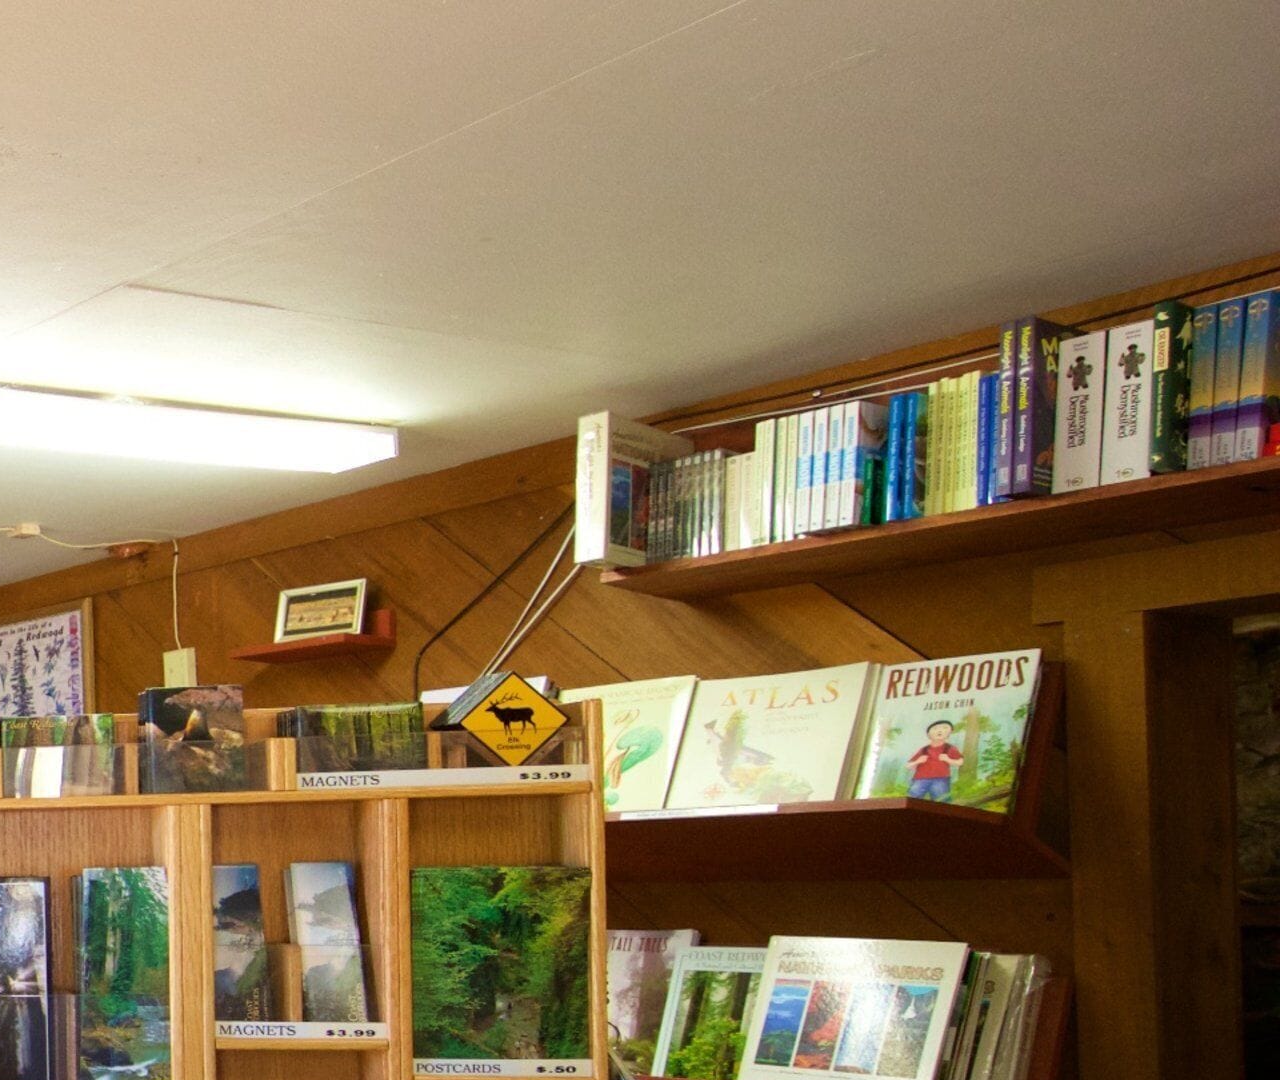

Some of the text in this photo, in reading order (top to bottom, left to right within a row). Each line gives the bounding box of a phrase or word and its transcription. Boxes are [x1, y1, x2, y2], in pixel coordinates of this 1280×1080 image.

[1117, 384, 1131, 439] Demystified
[1130, 383, 1142, 437] Mushrooms
[1066, 396, 1080, 449] Demystified
[1078, 394, 1090, 447] Mushrooms
[26, 625, 65, 642] Redwood
[885, 656, 1030, 700] REDWOODS
[720, 679, 842, 710] ATLAS
[496, 743, 532, 752] Crossing
[507, 736, 520, 744] Elk
[301, 771, 572, 788] MAGNETS $3.99
[610, 936, 633, 952] TALL
[689, 949, 725, 962] COAST
[219, 1025, 376, 1037] MAGNETS $3.99
[416, 1063, 577, 1074] POSTCARDS $.50
